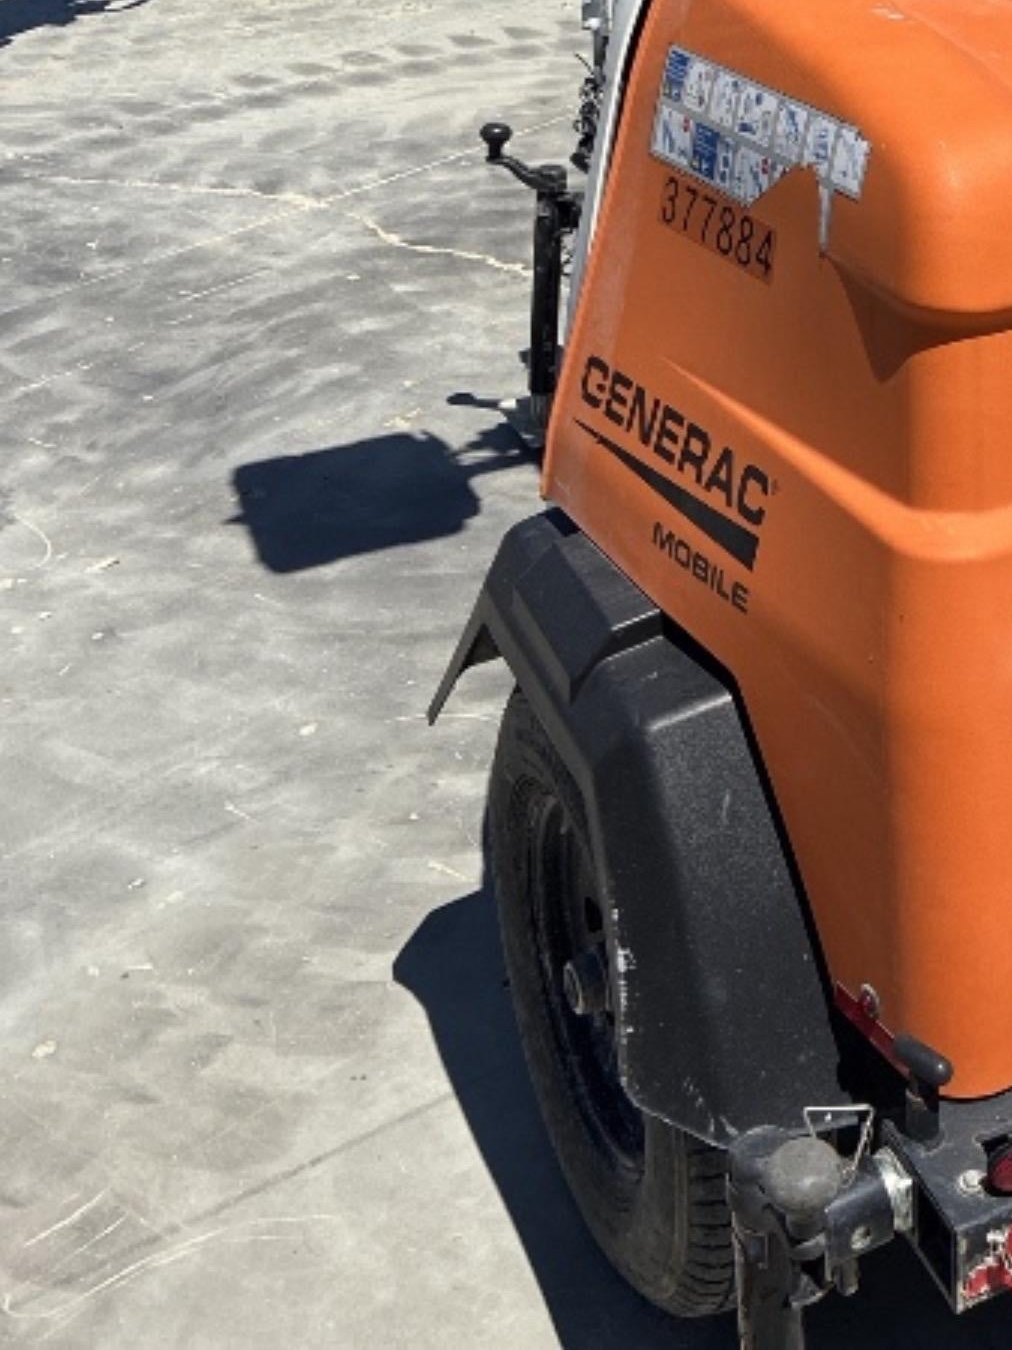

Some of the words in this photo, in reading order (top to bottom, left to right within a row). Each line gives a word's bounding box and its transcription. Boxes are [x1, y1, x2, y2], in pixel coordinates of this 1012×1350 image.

[662, 177, 774, 275] 377884
[580, 355, 770, 526] GENERAC
[653, 521, 749, 614] MOBILE
